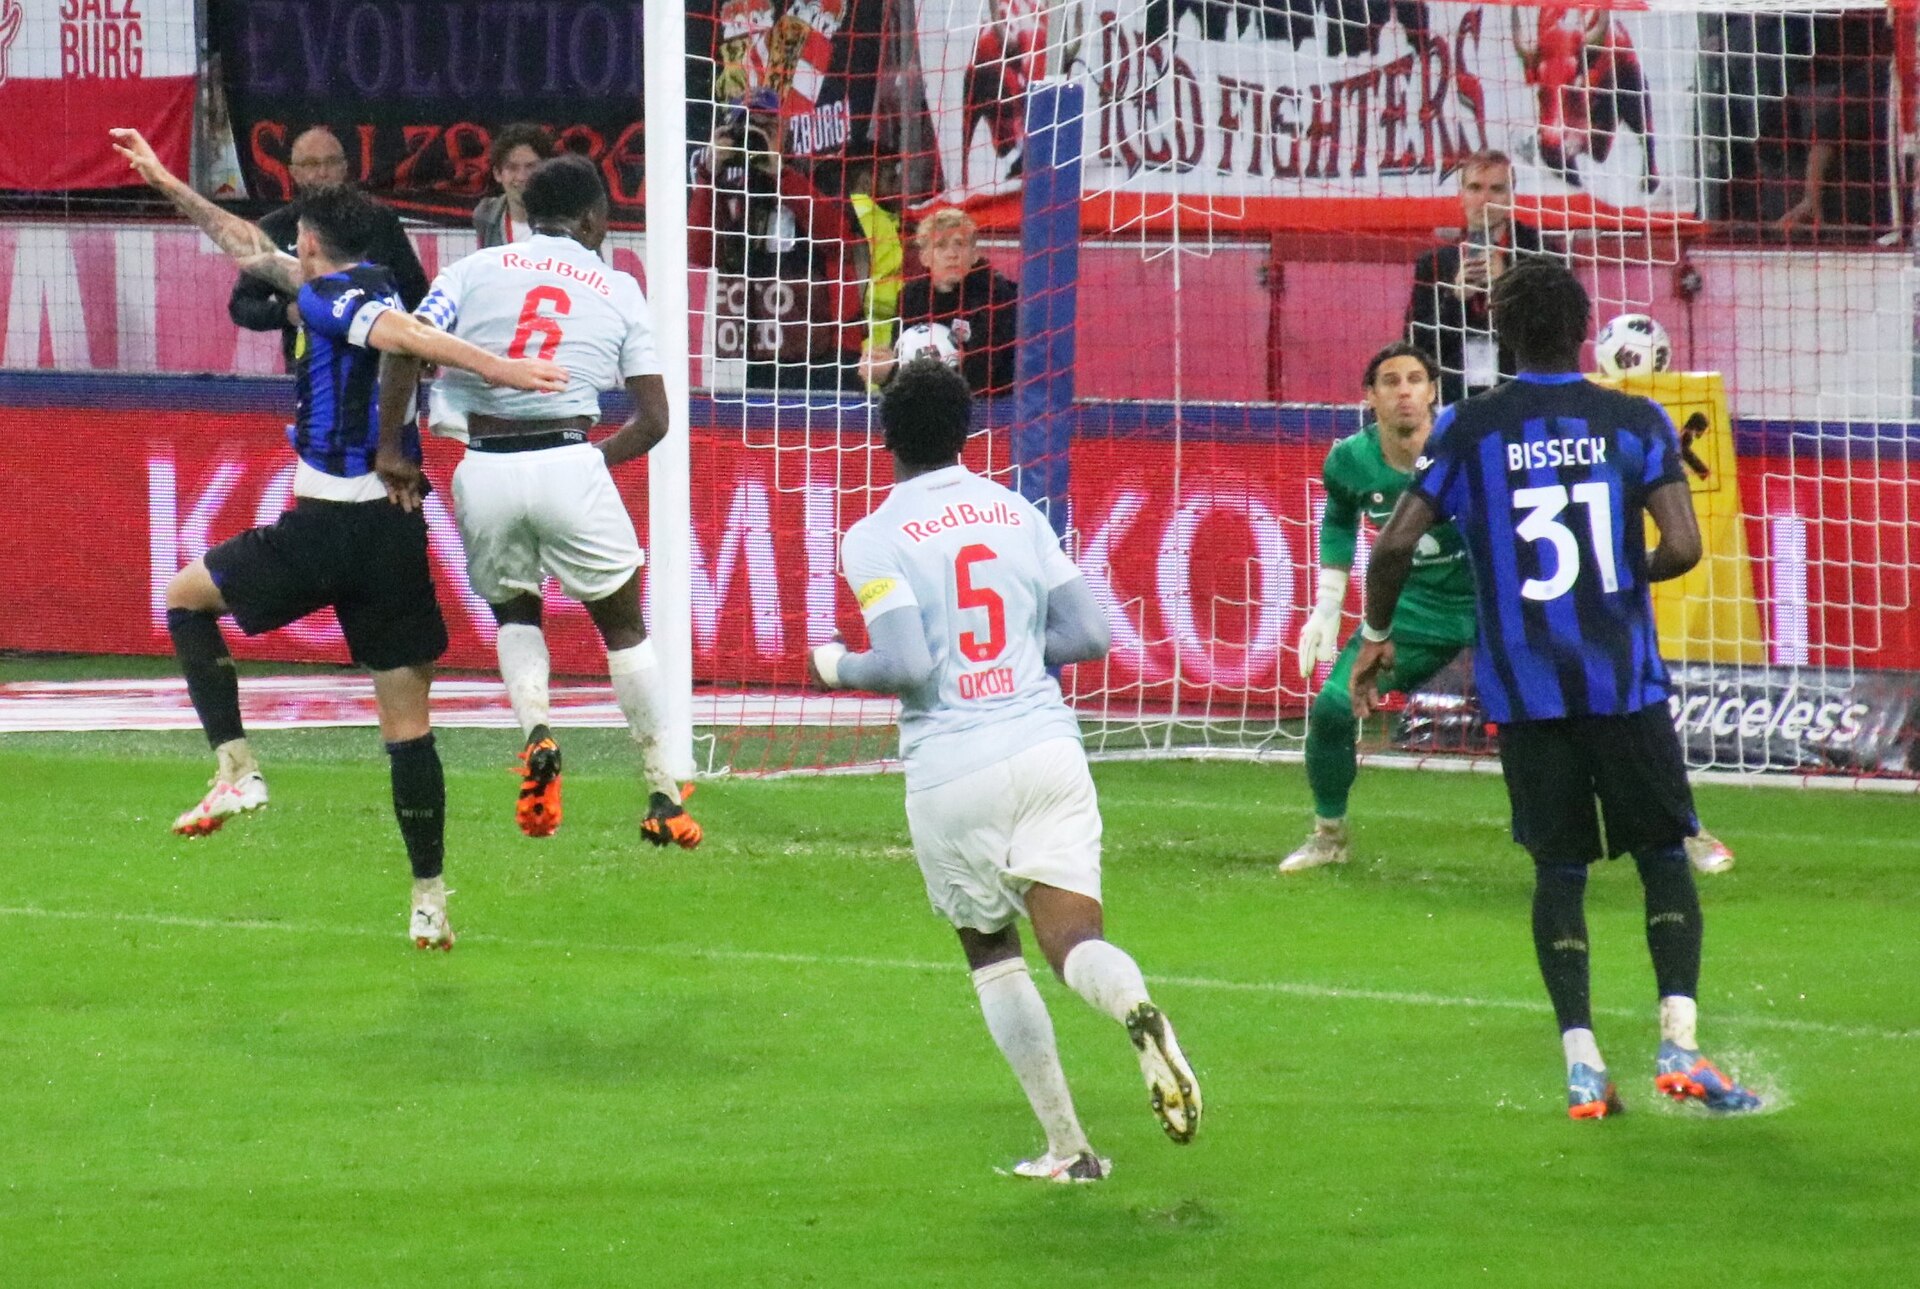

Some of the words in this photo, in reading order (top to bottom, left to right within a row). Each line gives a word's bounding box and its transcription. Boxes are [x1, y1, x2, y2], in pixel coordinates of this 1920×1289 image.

[61, 21, 142, 79] BURG
[503, 253, 552, 271] Red
[557, 262, 611, 296] Bulls
[507, 285, 571, 393] 6
[1508, 437, 1607, 471] BISSECK
[902, 506, 958, 542] Red
[957, 502, 1020, 526] Bulls
[1513, 481, 1619, 601] 31
[955, 543, 1007, 663] 5
[958, 667, 1014, 699] OKOH
